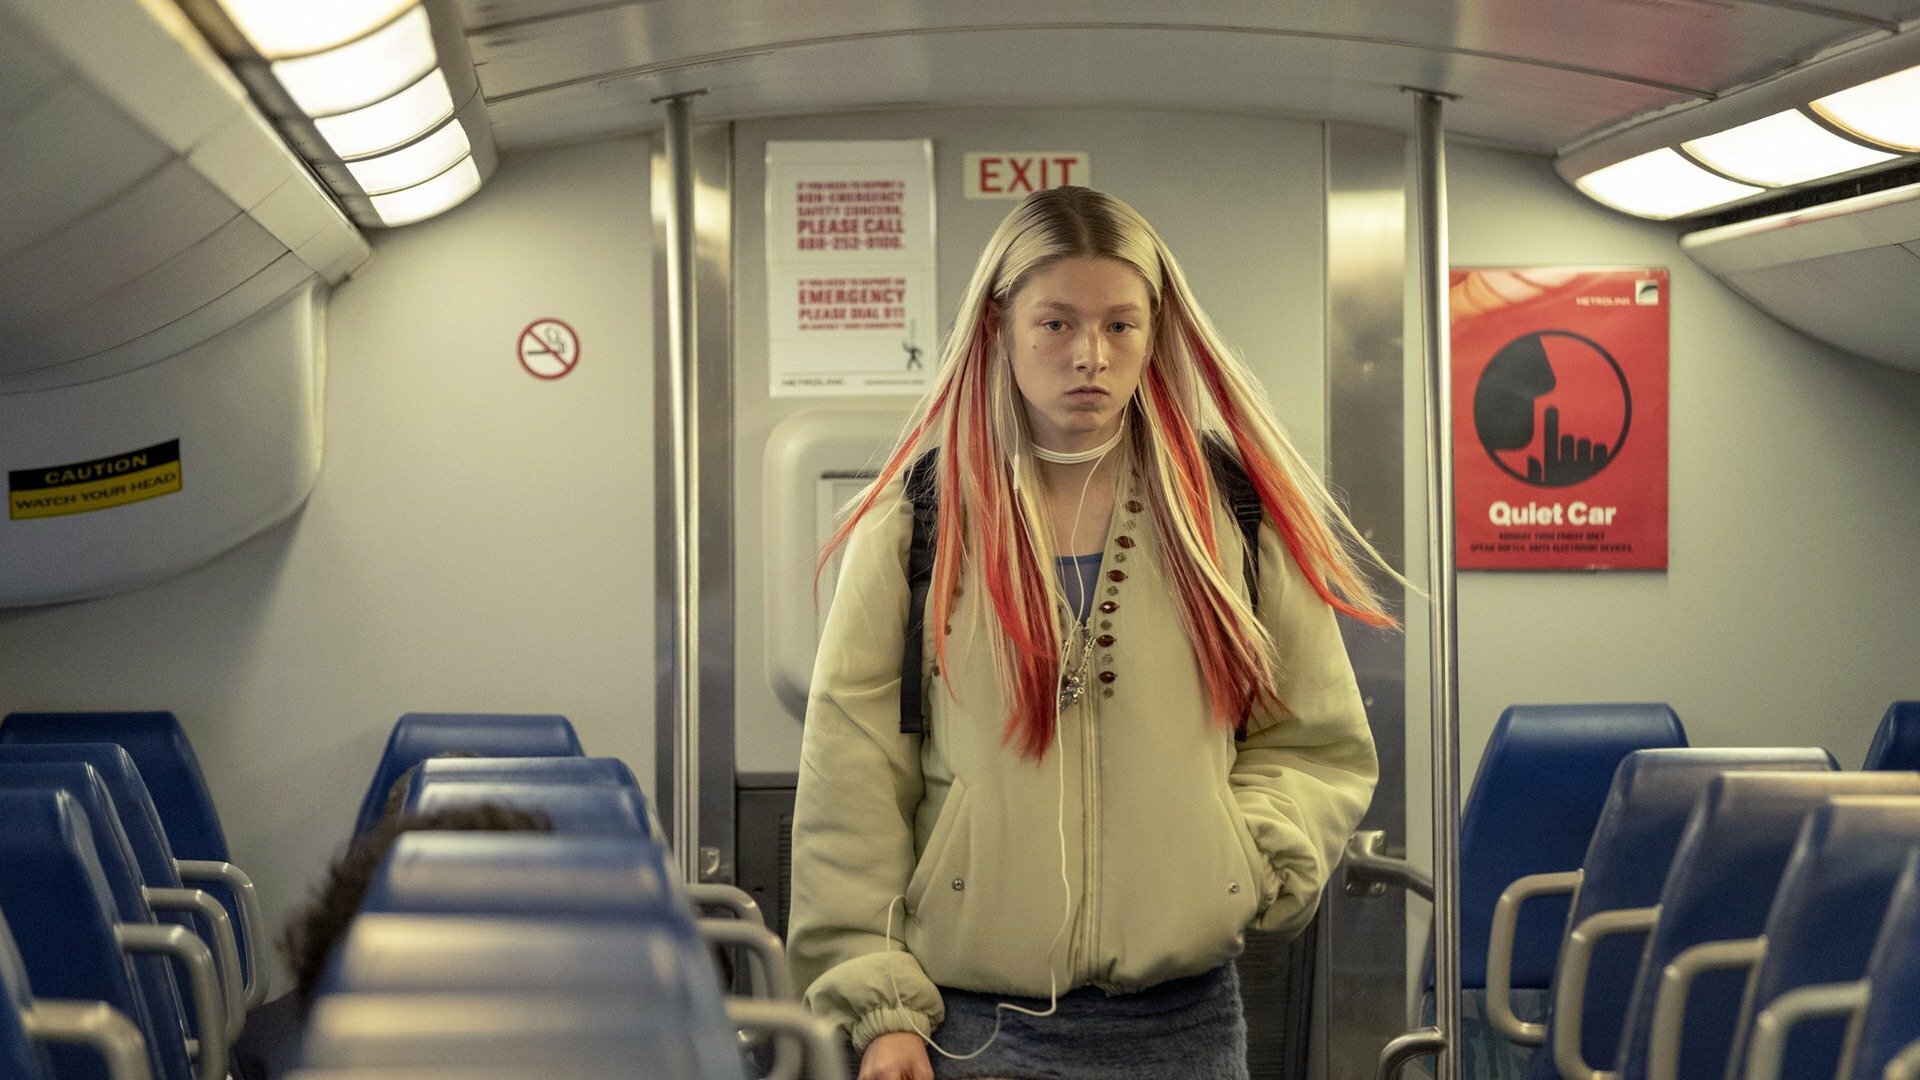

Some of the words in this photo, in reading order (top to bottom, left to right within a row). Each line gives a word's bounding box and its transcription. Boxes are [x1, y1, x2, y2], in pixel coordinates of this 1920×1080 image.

[979, 157, 1078, 193] EXIT
[797, 206, 839, 216] SAFETY
[797, 219, 859, 234] PLEASE
[863, 218, 904, 233] CALL
[798, 288, 905, 304] EMERGENCY
[798, 307, 847, 320] PLEASE
[850, 307, 880, 319] DIAL
[883, 307, 905, 319] 911
[44, 453, 148, 485] CAUTION
[15, 495, 77, 510] WATCH
[81, 485, 127, 501] YOUR
[131, 472, 178, 491] HEAD
[1489, 501, 1563, 527] Quiet
[1567, 501, 1617, 526] Car
